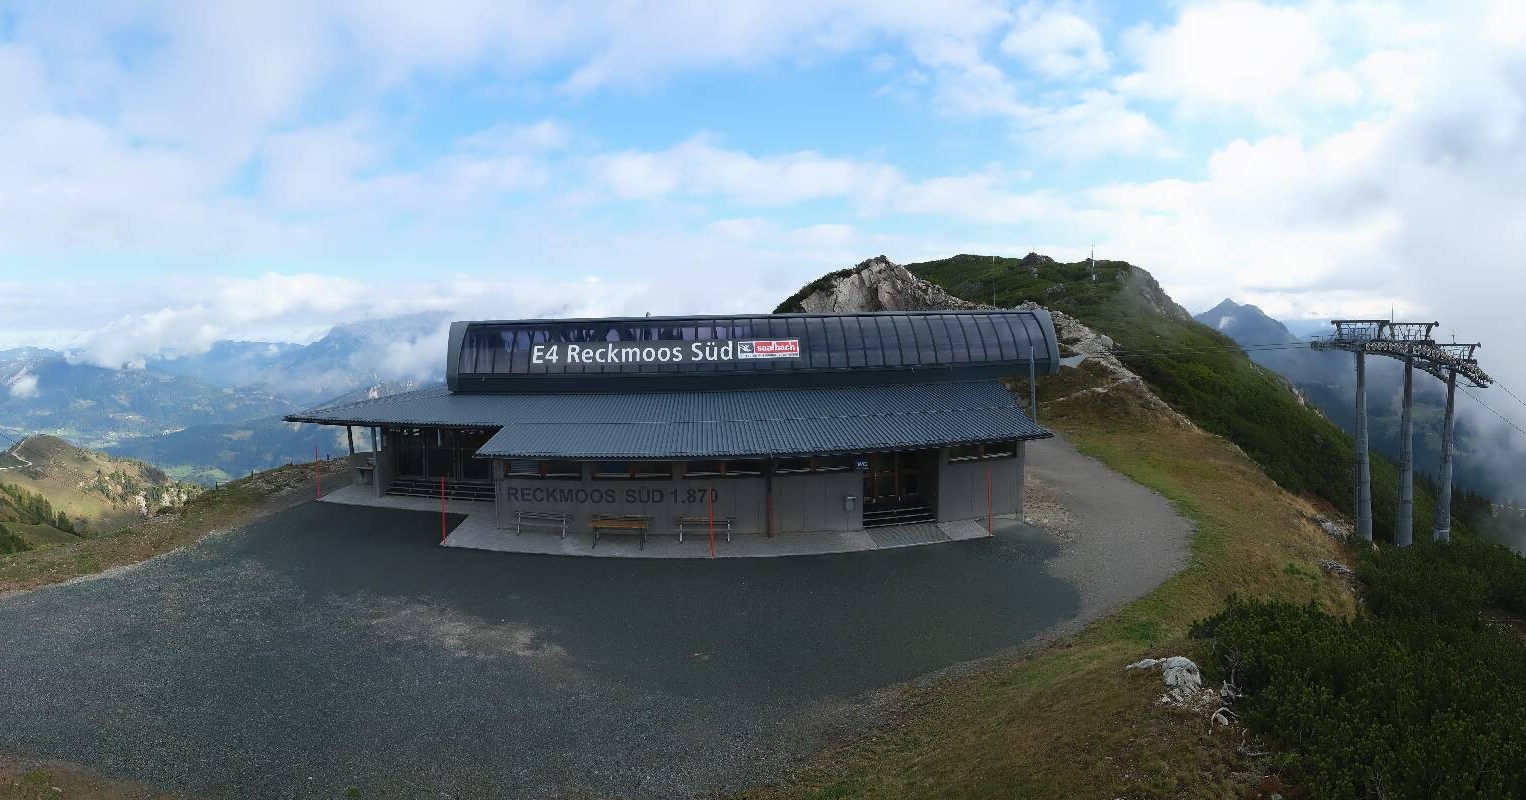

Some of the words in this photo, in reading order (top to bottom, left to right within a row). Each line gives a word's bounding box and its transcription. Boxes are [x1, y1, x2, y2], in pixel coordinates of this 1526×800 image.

[532, 345, 559, 364] E4
[567, 343, 683, 363] Reckmoos
[691, 341, 733, 361] Süd
[507, 486, 616, 504] RECKMOOS
[625, 486, 664, 504] SÜD
[670, 488, 719, 504] 1.870
